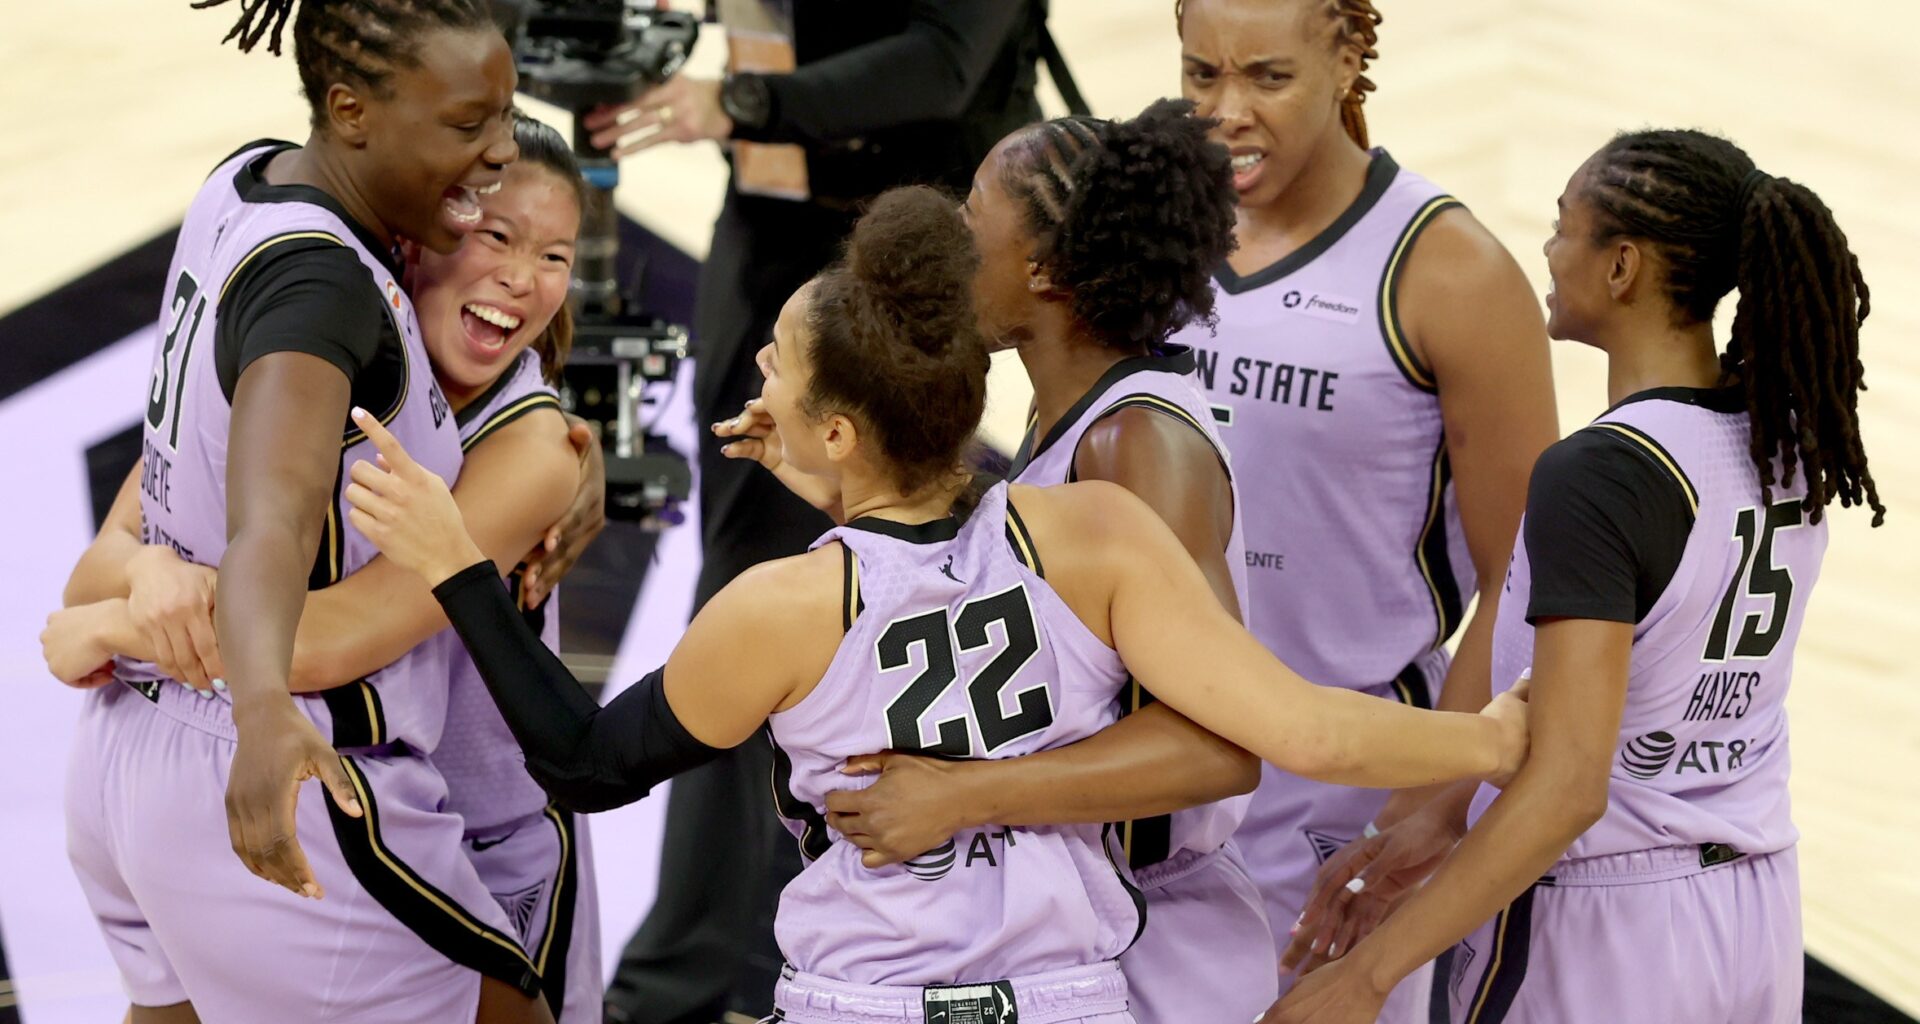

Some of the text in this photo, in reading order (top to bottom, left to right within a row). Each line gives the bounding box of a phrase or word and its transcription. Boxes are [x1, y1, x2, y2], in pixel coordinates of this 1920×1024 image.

[145, 266, 207, 453] 31
[1304, 294, 1358, 315] freedom
[1230, 356, 1339, 411] STATE
[1701, 497, 1804, 664] 15
[874, 580, 1055, 757] 22
[1682, 671, 1760, 721] HAYES
